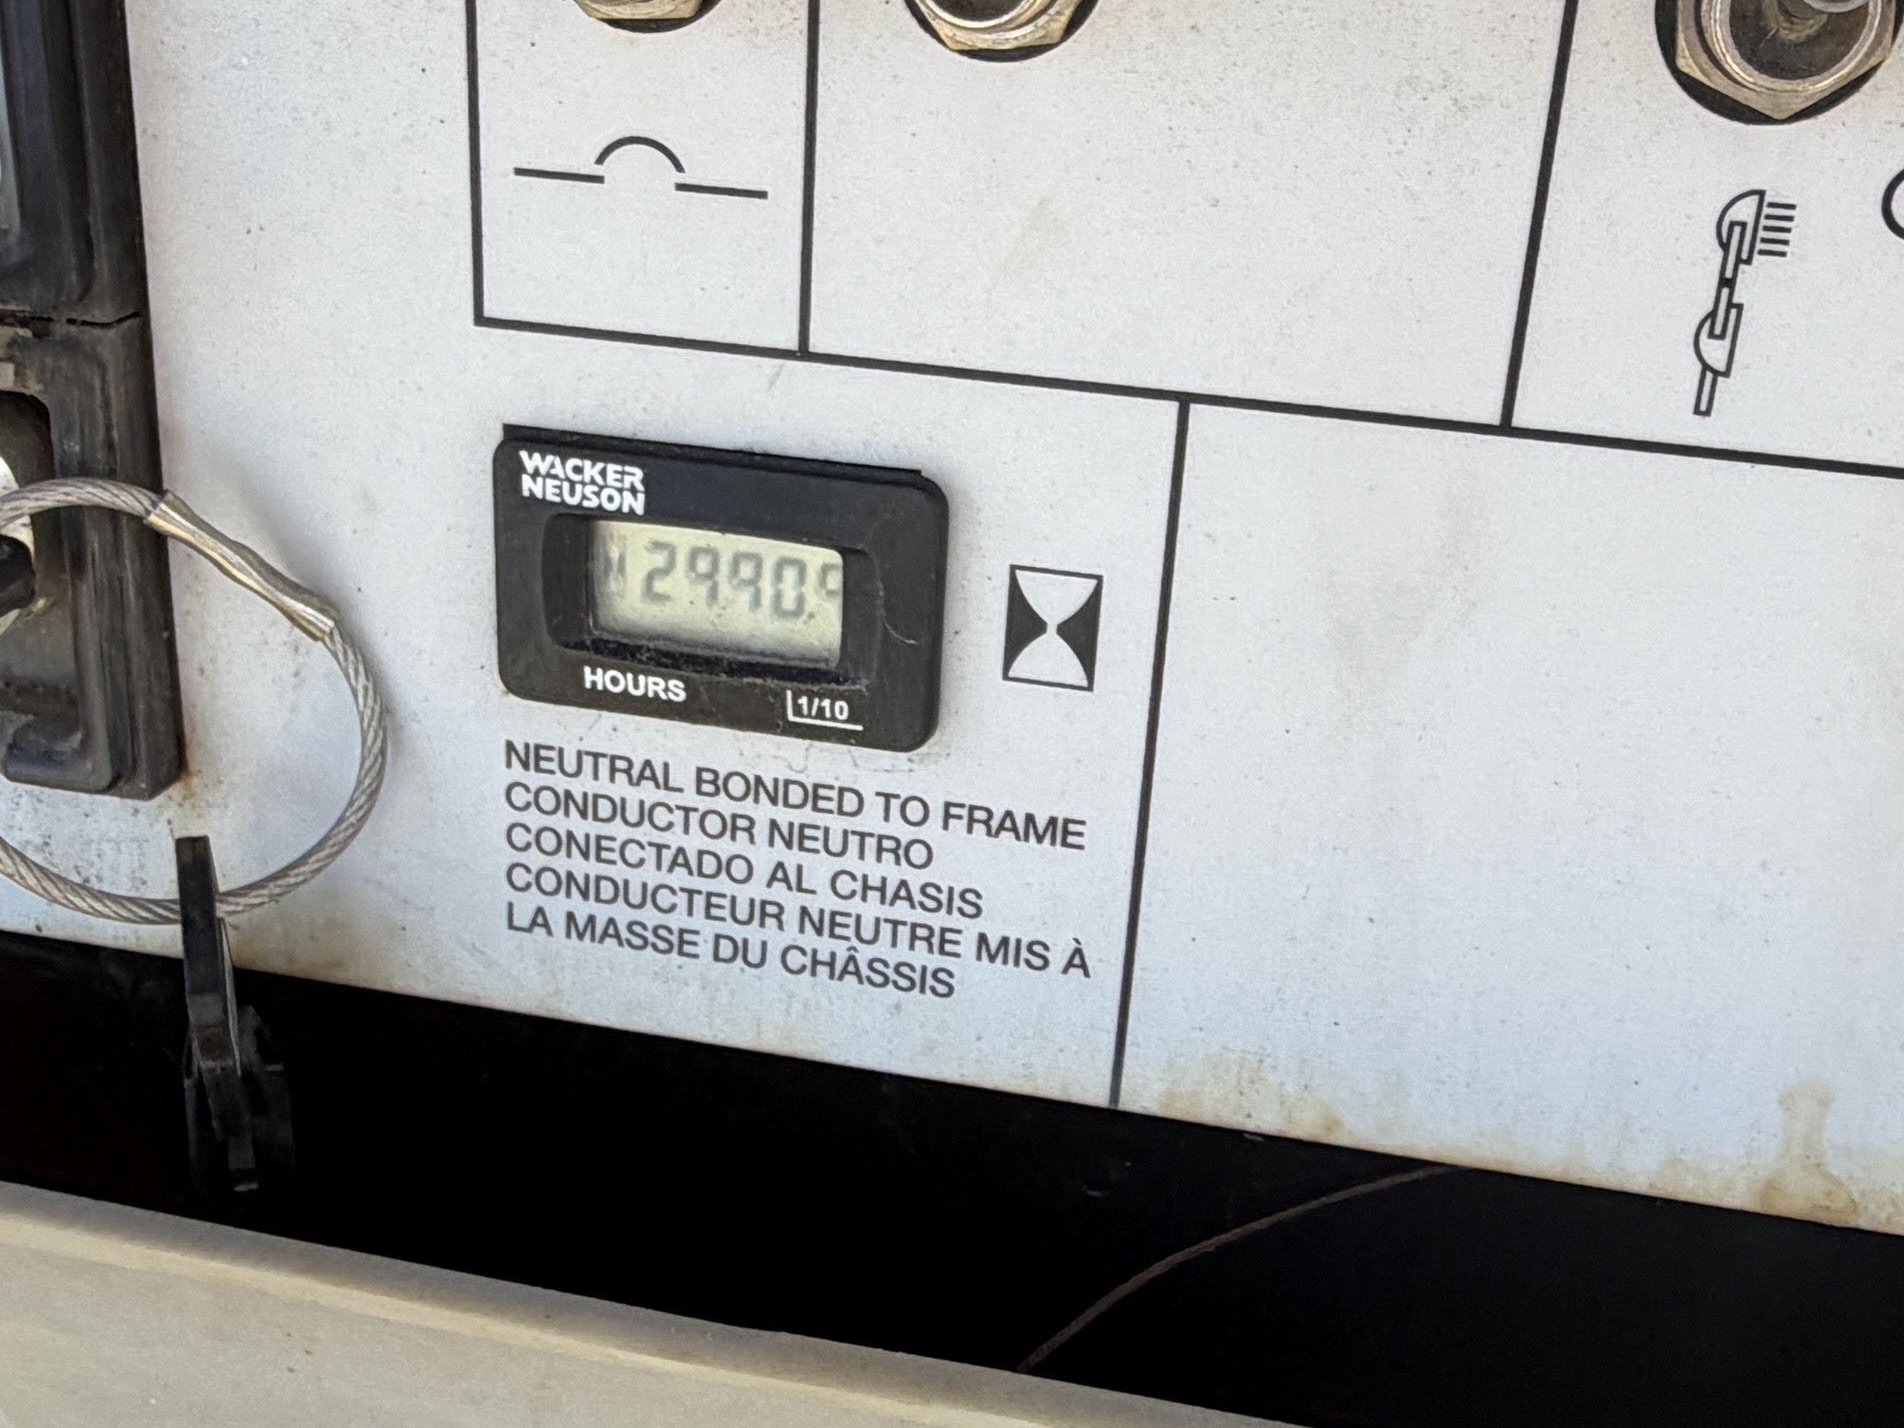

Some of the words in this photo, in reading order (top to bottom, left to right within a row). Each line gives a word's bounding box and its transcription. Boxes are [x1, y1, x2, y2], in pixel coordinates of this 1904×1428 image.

[520, 450, 645, 492] WACKER
[521, 474, 646, 515] NEUSON
[584, 667, 687, 703] HOURS
[797, 696, 849, 721] 1/10
[504, 782, 755, 844] CONDUCTOR
[768, 818, 933, 870] NEUTRO
[505, 741, 683, 794] NEUTRAL
[695, 766, 863, 818] BONDED
[877, 793, 930, 828] TO
[942, 802, 1085, 850] FRAME
[506, 823, 753, 884] CONECTADO
[766, 860, 816, 894] AL
[830, 870, 984, 919] CHASIS
[506, 863, 784, 931] CONDUCTEUR
[799, 907, 962, 957] NEUTRE
[976, 933, 1050, 971] MIS
[1063, 938, 1091, 978] À
[507, 902, 552, 938] LA
[565, 911, 699, 960] MASSE
[713, 933, 767, 968] DU
[780, 938, 956, 999] CHÂSSIS
